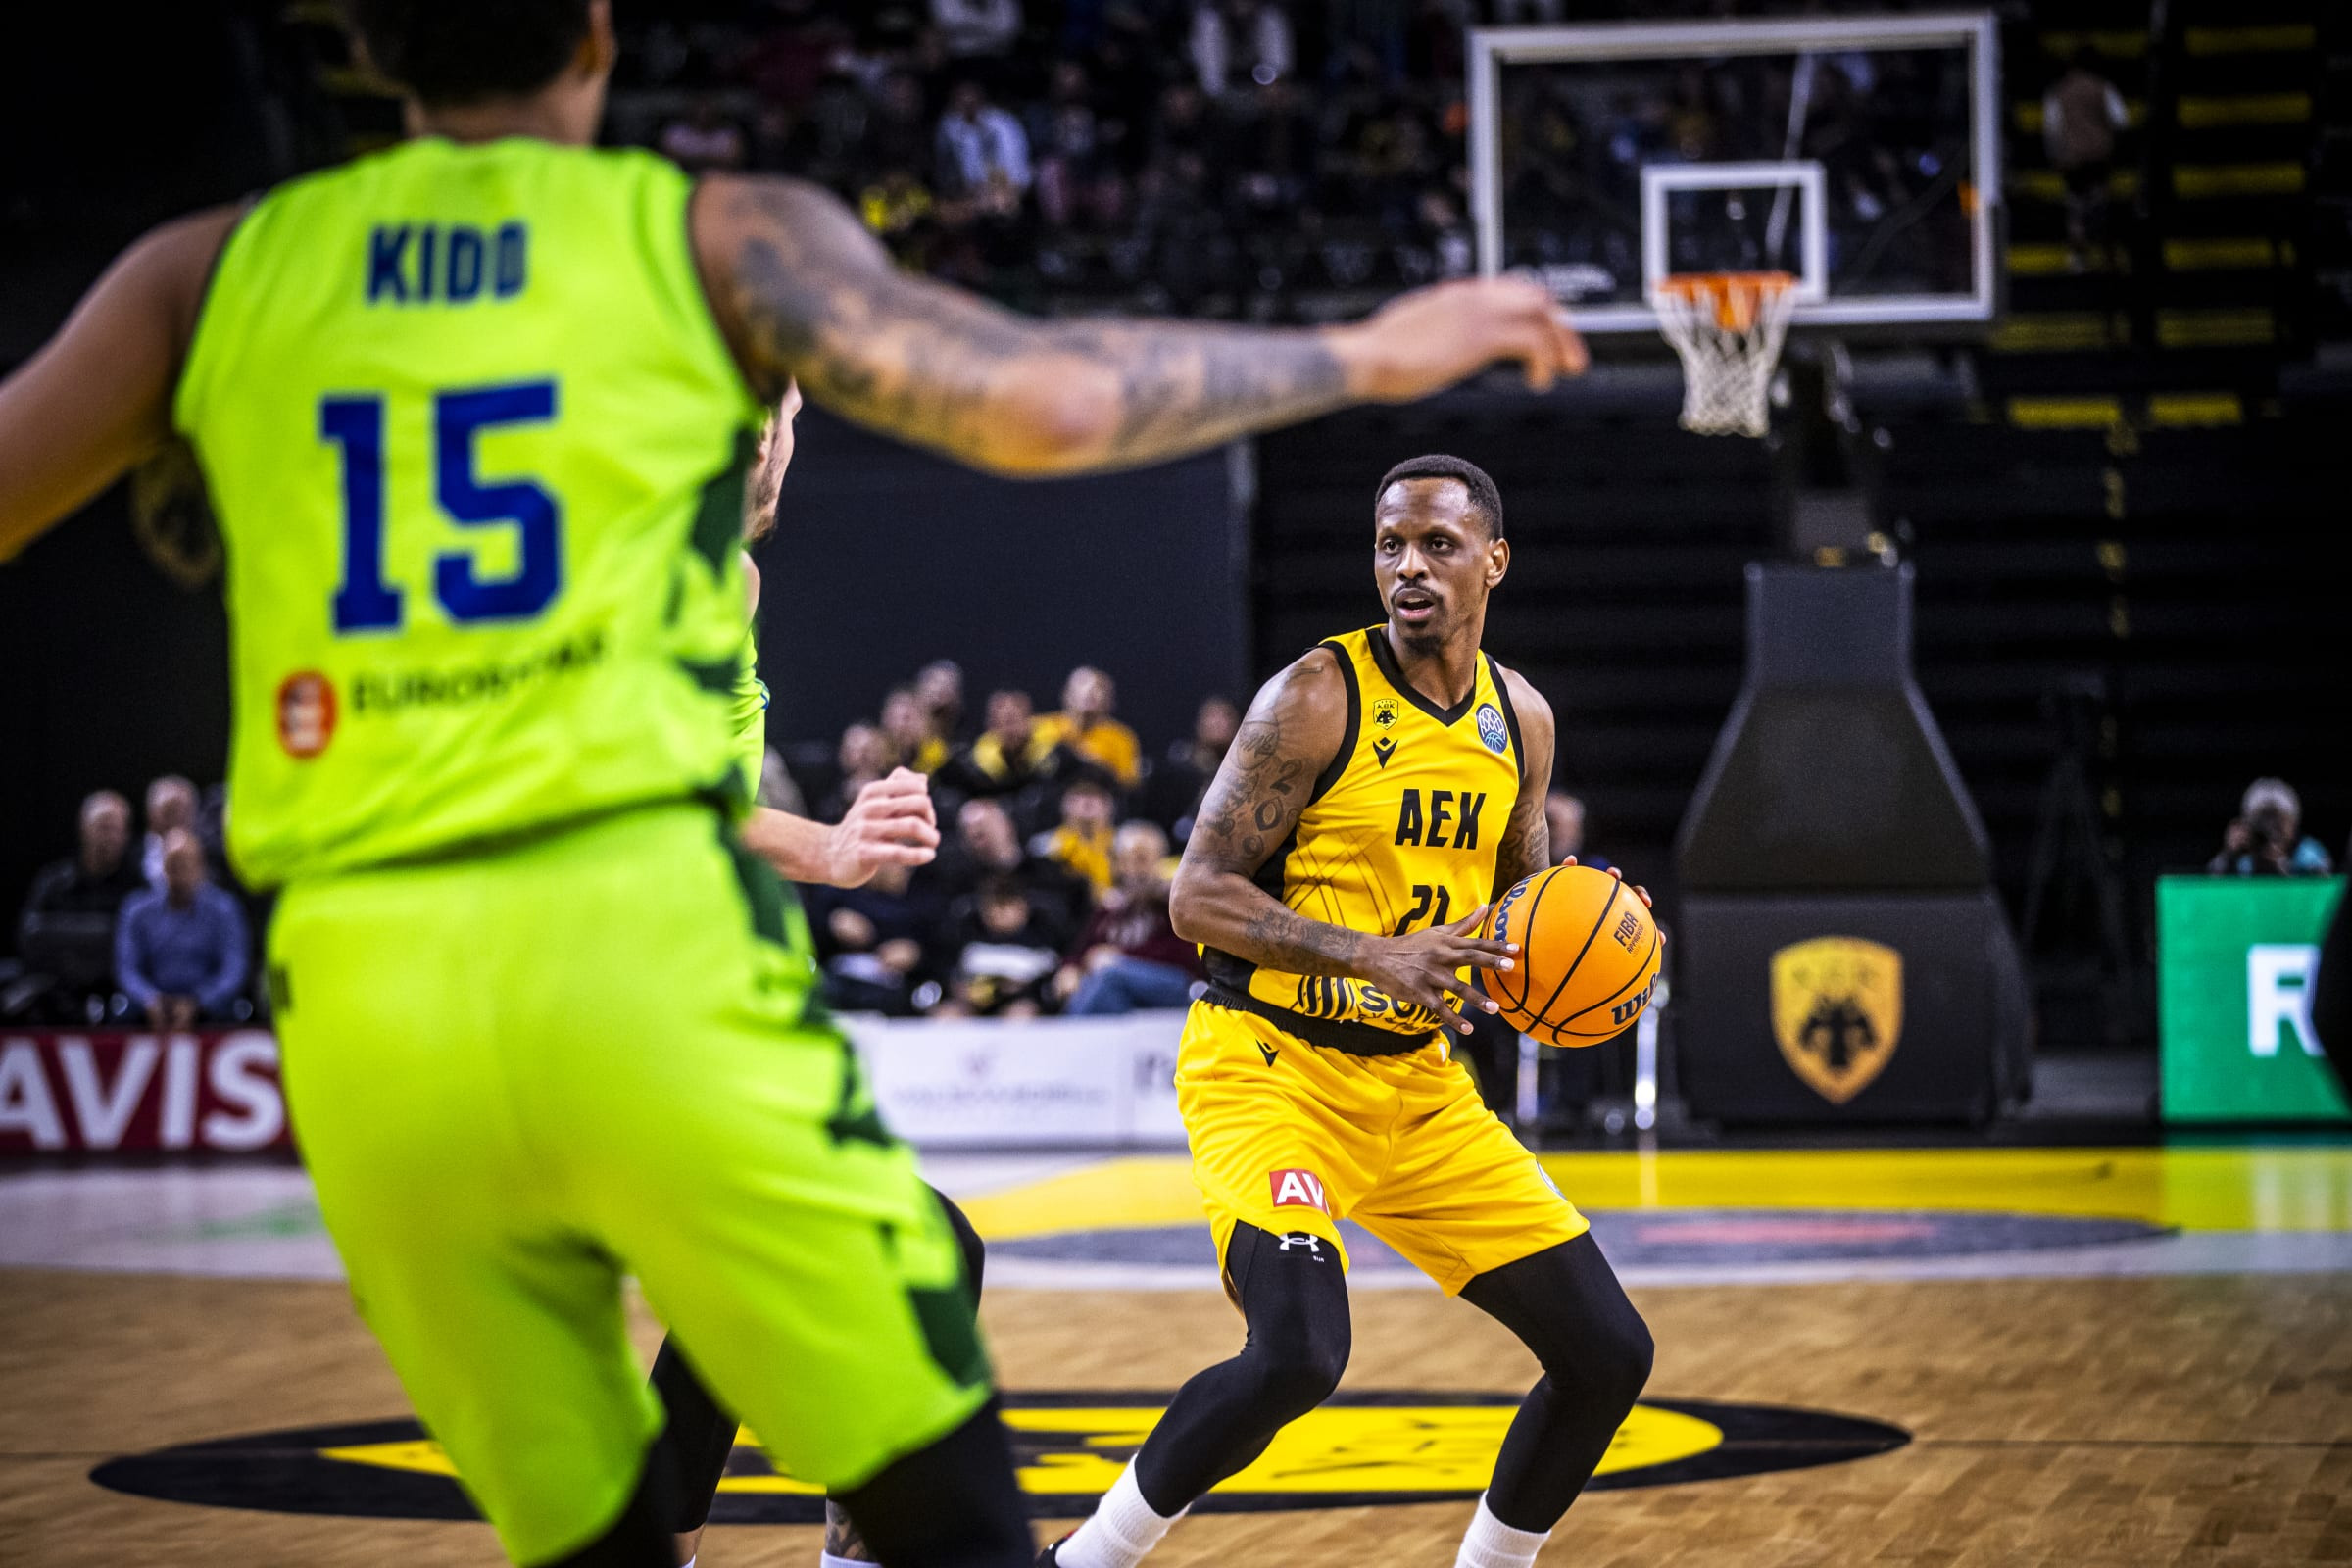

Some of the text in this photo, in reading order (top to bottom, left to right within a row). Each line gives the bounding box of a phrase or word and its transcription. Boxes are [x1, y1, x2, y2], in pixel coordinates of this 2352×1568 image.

[367, 221, 527, 304] KIDD
[319, 377, 562, 634] 15
[1395, 789, 1487, 850] AEK
[1393, 885, 1450, 937] 21
[1613, 910, 1639, 947] FIBA
[0, 1035, 284, 1150] AVIS
